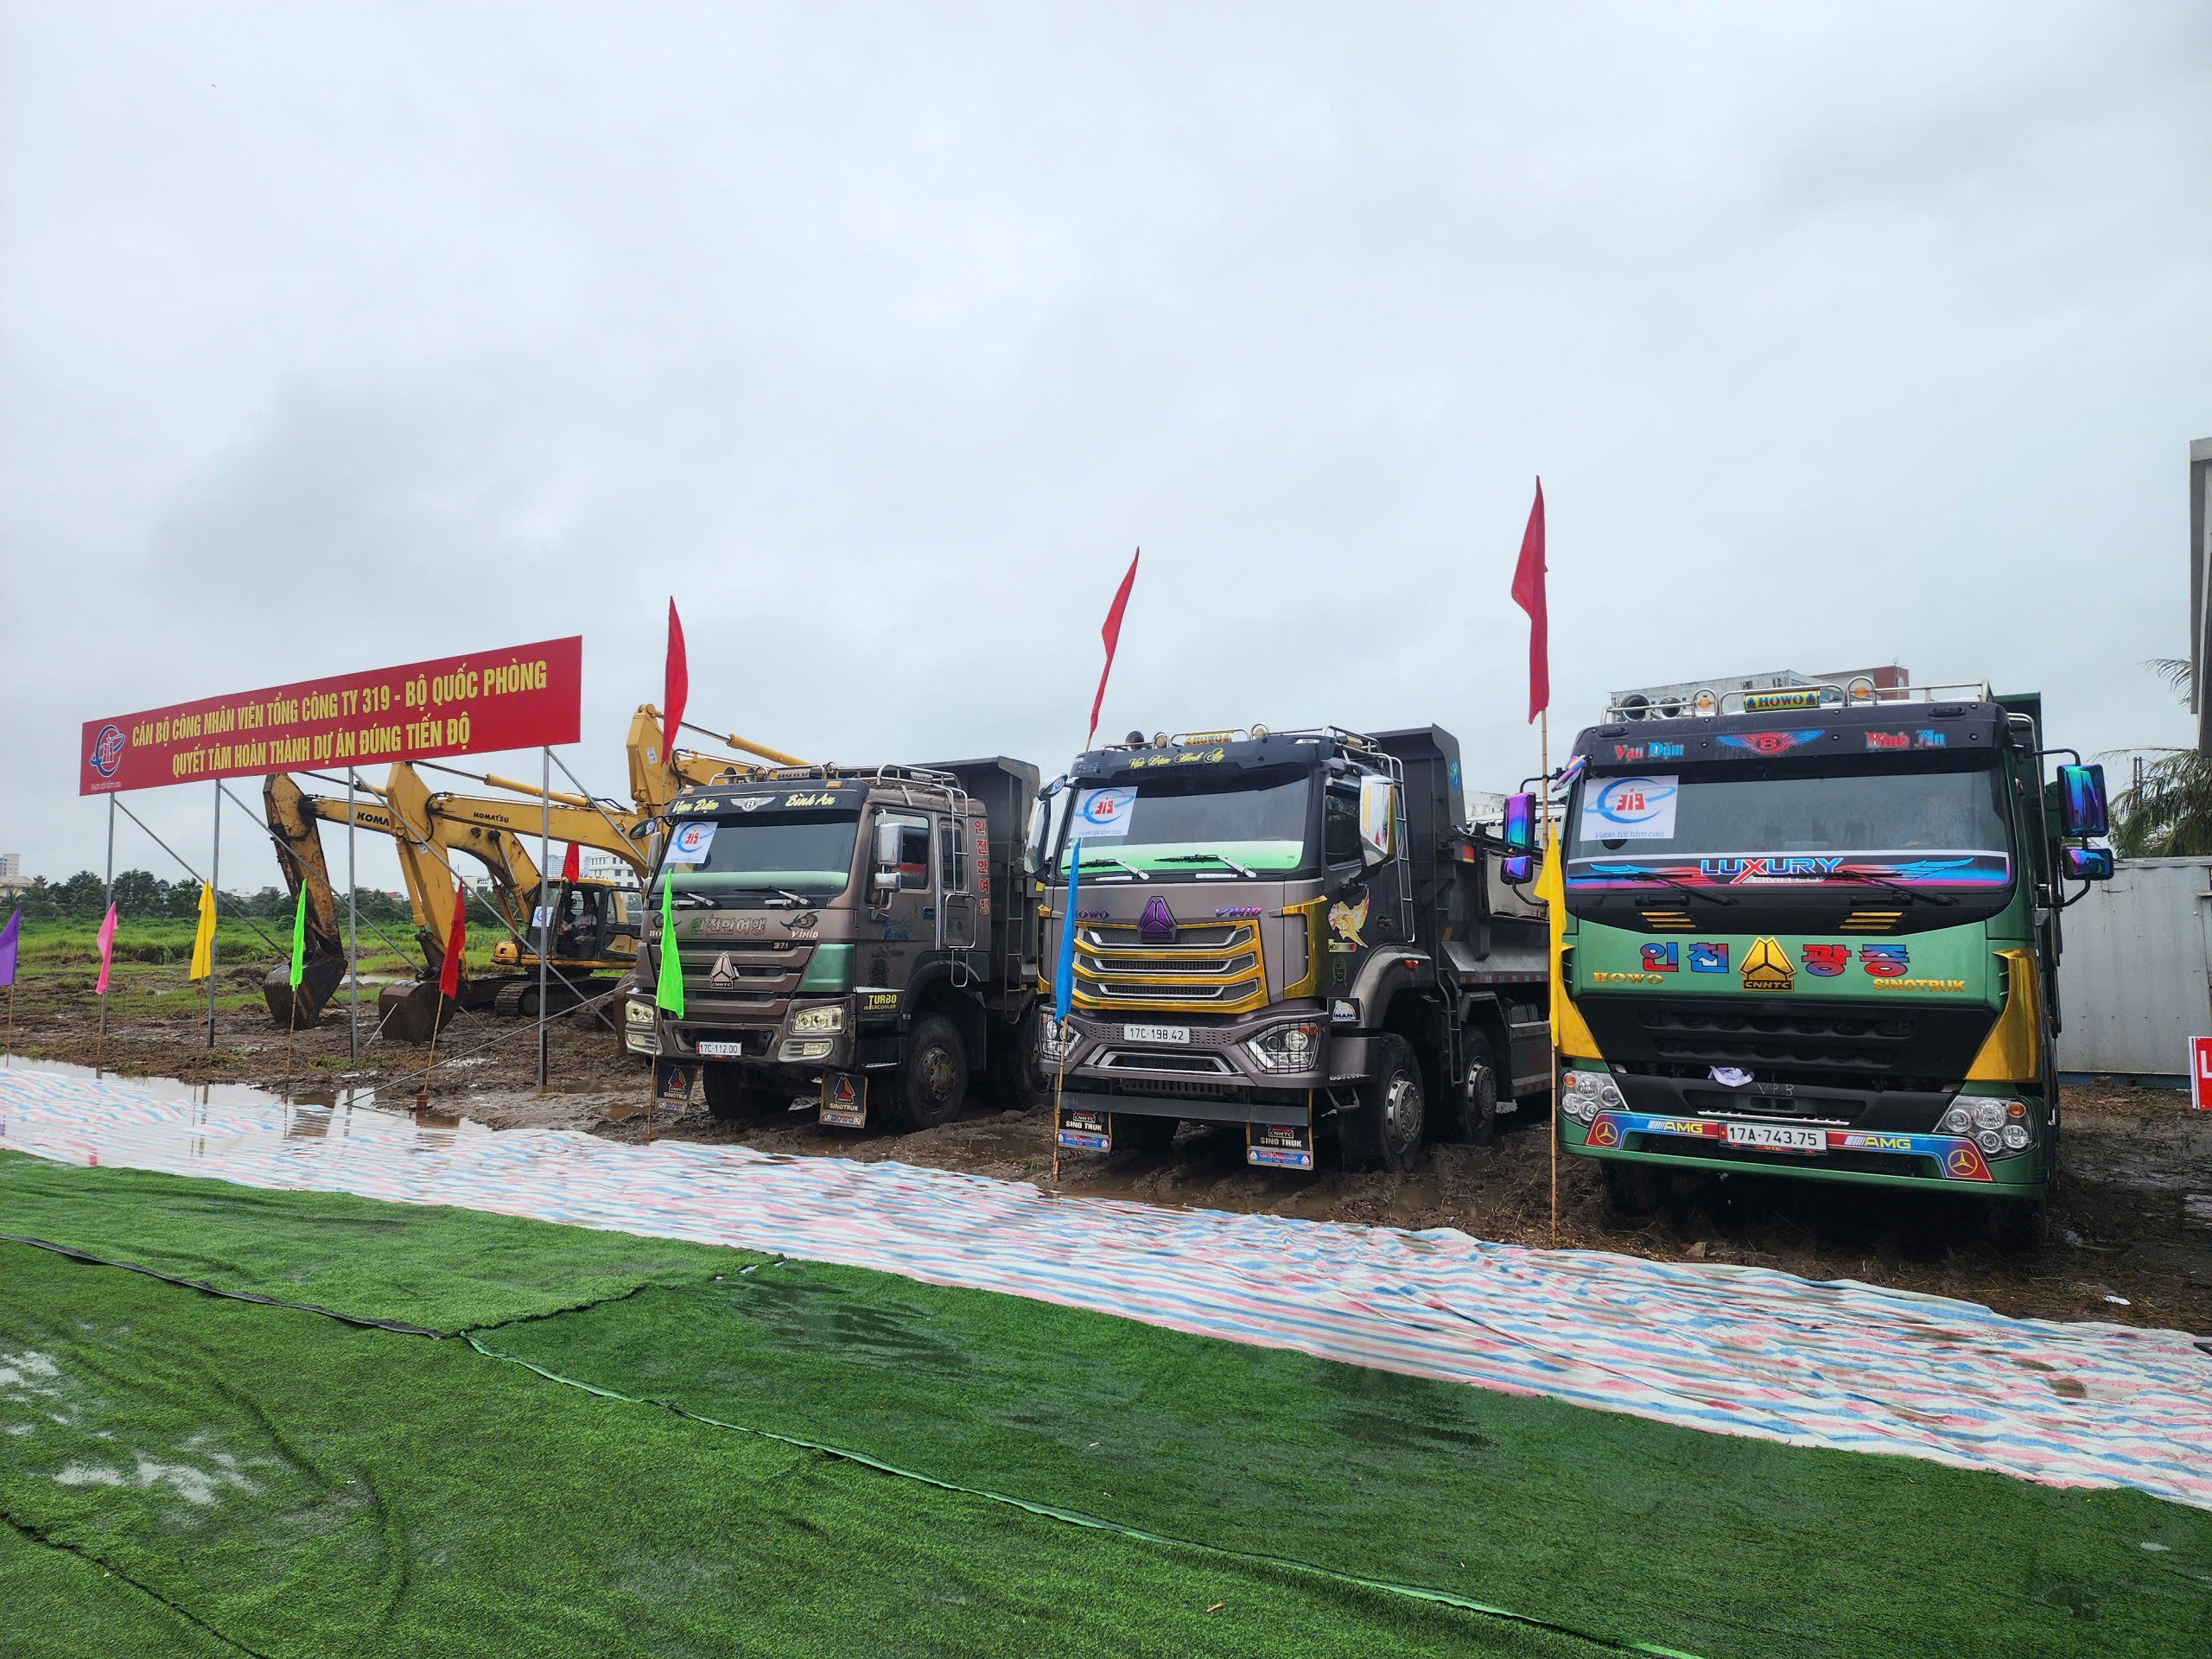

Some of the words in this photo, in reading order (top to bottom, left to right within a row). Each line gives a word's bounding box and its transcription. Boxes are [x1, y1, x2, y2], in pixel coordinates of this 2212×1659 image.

[132, 721, 153, 747] CÁN
[156, 716, 169, 747] BỘ
[172, 713, 200, 741] CÔNG
[204, 706, 234, 735] NHÂN
[238, 701, 264, 730] VIÊN
[267, 692, 298, 727] TỔNG
[302, 691, 338, 721] CÔNG
[341, 690, 358, 716] TY
[362, 685, 390, 714] 319
[405, 674, 427, 711] BỘ
[432, 663, 478, 706] QUỐC
[484, 658, 547, 696] PHÒNG
[1758, 695, 1803, 708] HOWO
[173, 743, 205, 779] QUYẾT
[208, 743, 231, 771] TÂM
[234, 739, 266, 768] HOÀN
[269, 734, 309, 765] THÀNH
[314, 731, 334, 764] DỰ
[335, 728, 355, 759] ÁN
[359, 721, 401, 756] ĐÚNG
[406, 713, 442, 750] TIẾN
[447, 711, 470, 750] ĐỘ
[357, 812, 389, 825] KOMA
[474, 811, 509, 823] KOMATSU
[1700, 857, 1844, 884] LUXURY
[1075, 910, 1110, 919] OWO
[1592, 972, 1663, 985] HOWO
[1873, 978, 1966, 993] SINOTRUK
[868, 995, 897, 1009] TURBO
[700, 1045, 737, 1054] 17C-112.00
[830, 1103, 858, 1111] SINOTRUK
[1662, 1121, 1703, 1134] AMG
[1260, 1136, 1279, 1145] SINO
[1281, 1139, 1302, 1147] TRUK
[1729, 1127, 1817, 1146] 17A-743.75
[1863, 1135, 1911, 1149] AMG
